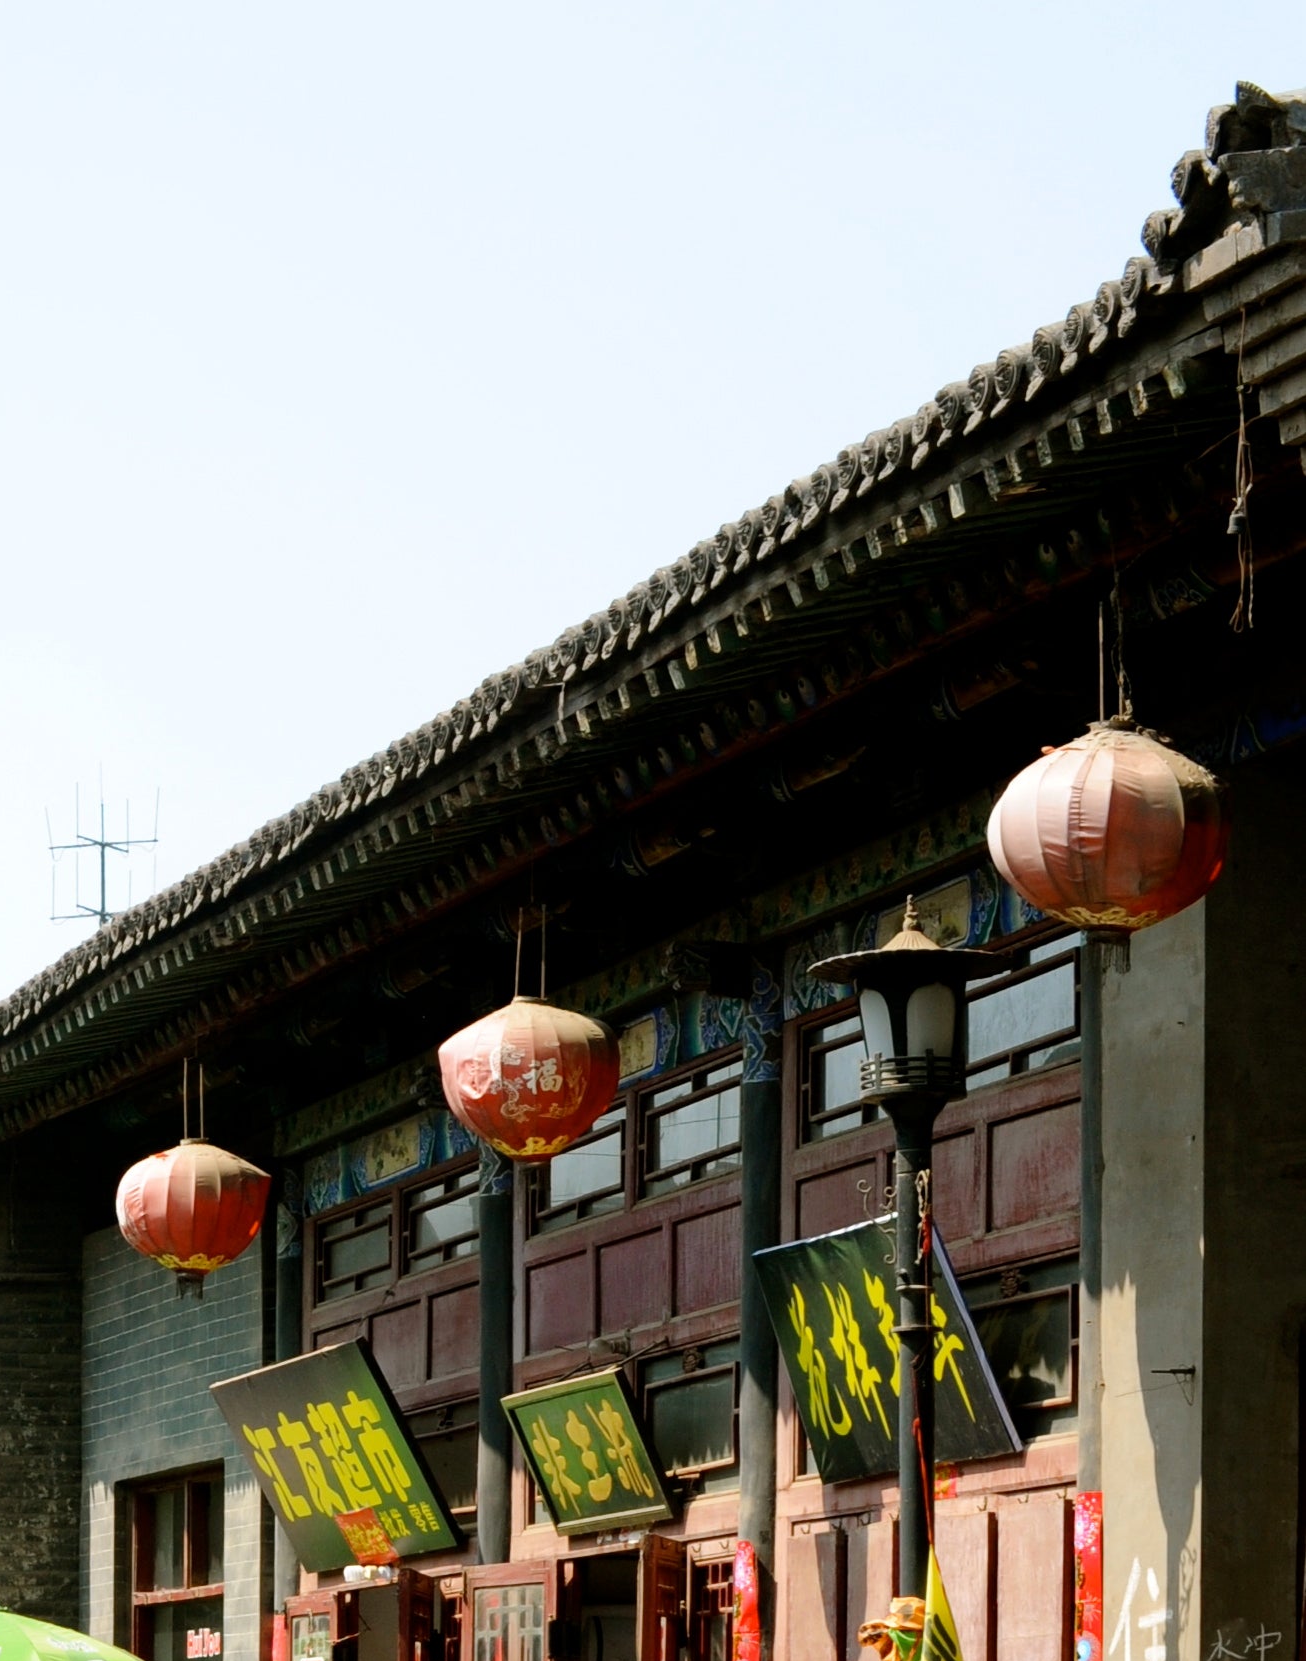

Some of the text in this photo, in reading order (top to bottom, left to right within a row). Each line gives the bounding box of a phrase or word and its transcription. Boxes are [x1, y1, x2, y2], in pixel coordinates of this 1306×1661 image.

[523, 1057, 563, 1095] 福
[243, 1391, 412, 1522] 汇友超市
